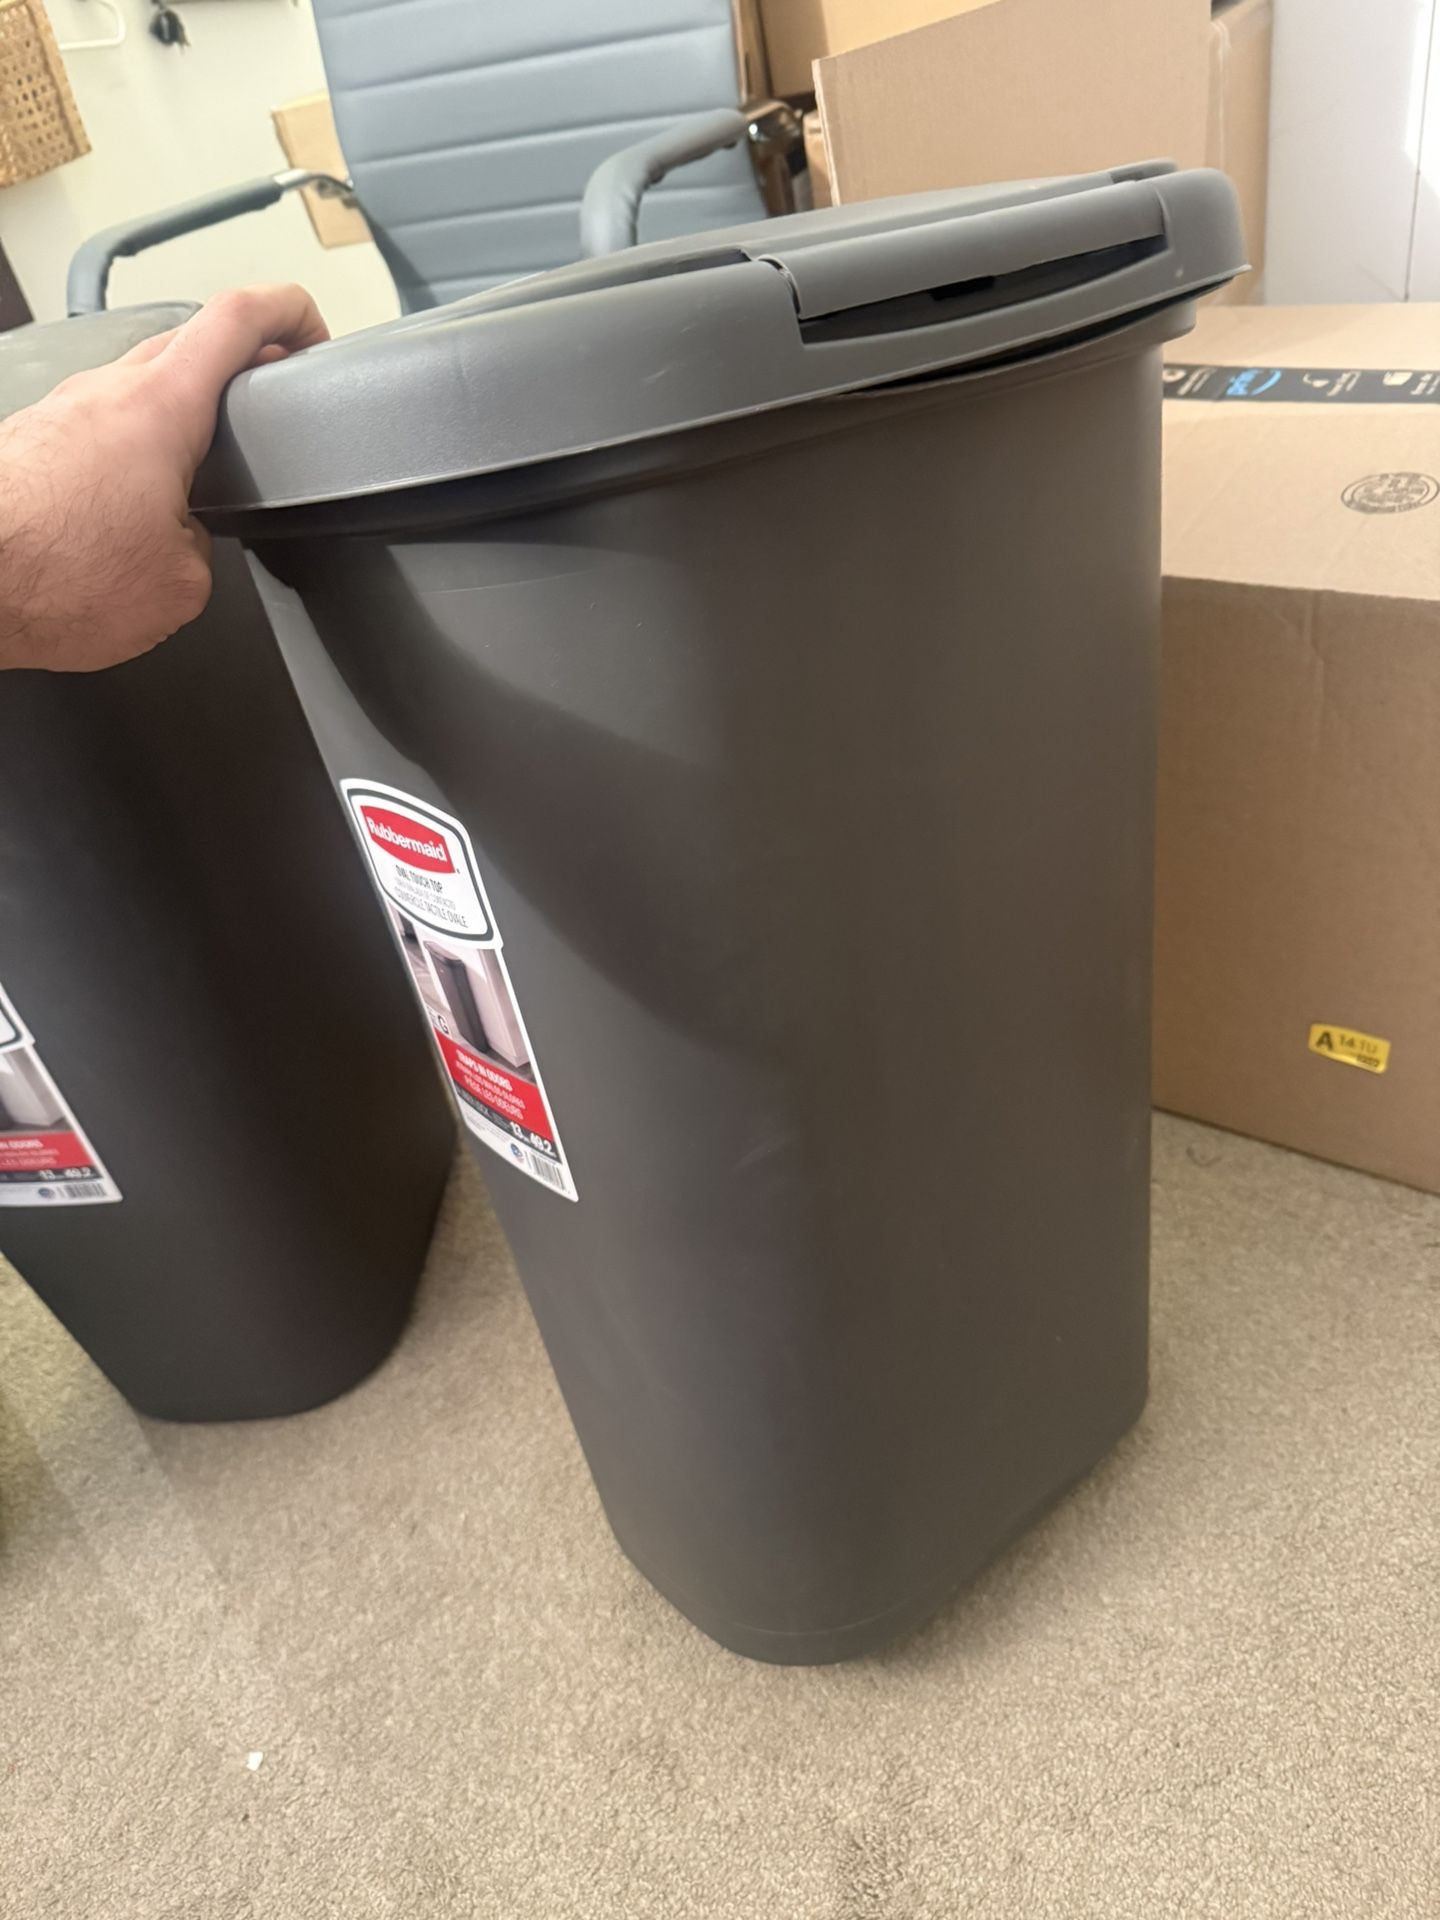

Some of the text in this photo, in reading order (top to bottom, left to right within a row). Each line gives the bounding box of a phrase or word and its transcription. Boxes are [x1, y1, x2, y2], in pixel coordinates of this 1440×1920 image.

[366, 816, 447, 863] Rubbermaid
[429, 878, 443, 894] TOP
[447, 910, 469, 929] OVALE
[1315, 1030, 1334, 1051] A
[1339, 1033, 1355, 1049] 14
[510, 1121, 524, 1139] 13
